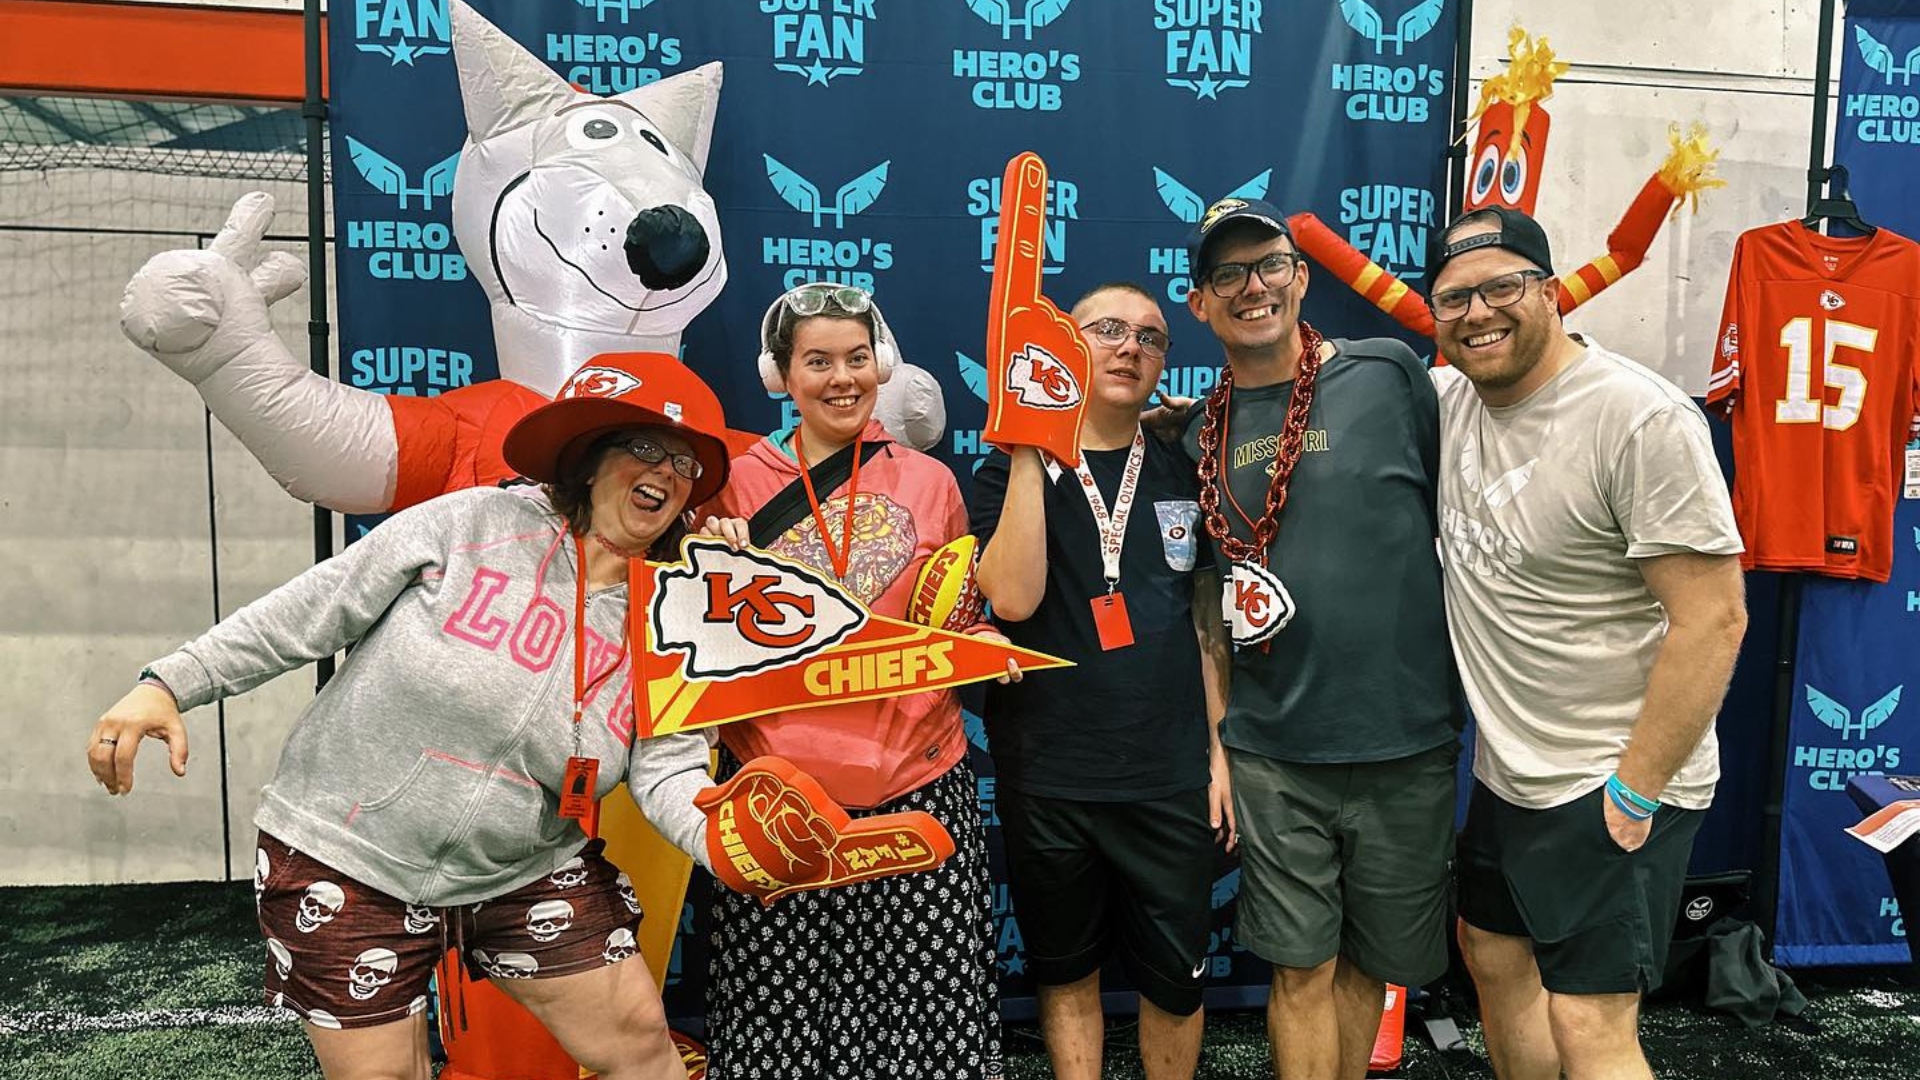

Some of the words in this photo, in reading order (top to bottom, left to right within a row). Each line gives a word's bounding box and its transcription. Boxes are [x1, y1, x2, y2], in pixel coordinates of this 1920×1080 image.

[355, 0, 451, 42] FAN
[1153, 0, 1262, 33] SUPER
[546, 32, 682, 66] HERO'S
[774, 14, 864, 63] FAN
[1166, 29, 1250, 76] FAN
[953, 50, 1081, 81] HERO'S
[1331, 64, 1444, 95] HERO'S
[972, 81, 1062, 111] CLUB
[1346, 94, 1429, 122] CLUB
[1340, 185, 1436, 228] SUPER
[368, 251, 468, 281] CLUB
[763, 237, 894, 270] HERO'S
[1348, 222, 1427, 268] FAN
[352, 346, 474, 388] SUPER
[1030, 358, 1070, 401] KC
[1775, 317, 1879, 432] 15
[1234, 429, 1330, 469] MISSRI
[1108, 508, 1128, 555] SPECIAL
[1119, 451, 1142, 505] OLYMPICS
[702, 571, 817, 648] KC
[1234, 579, 1270, 628] KC
[803, 640, 954, 697] CHIEFS
[1794, 745, 1901, 769] HERO'S
